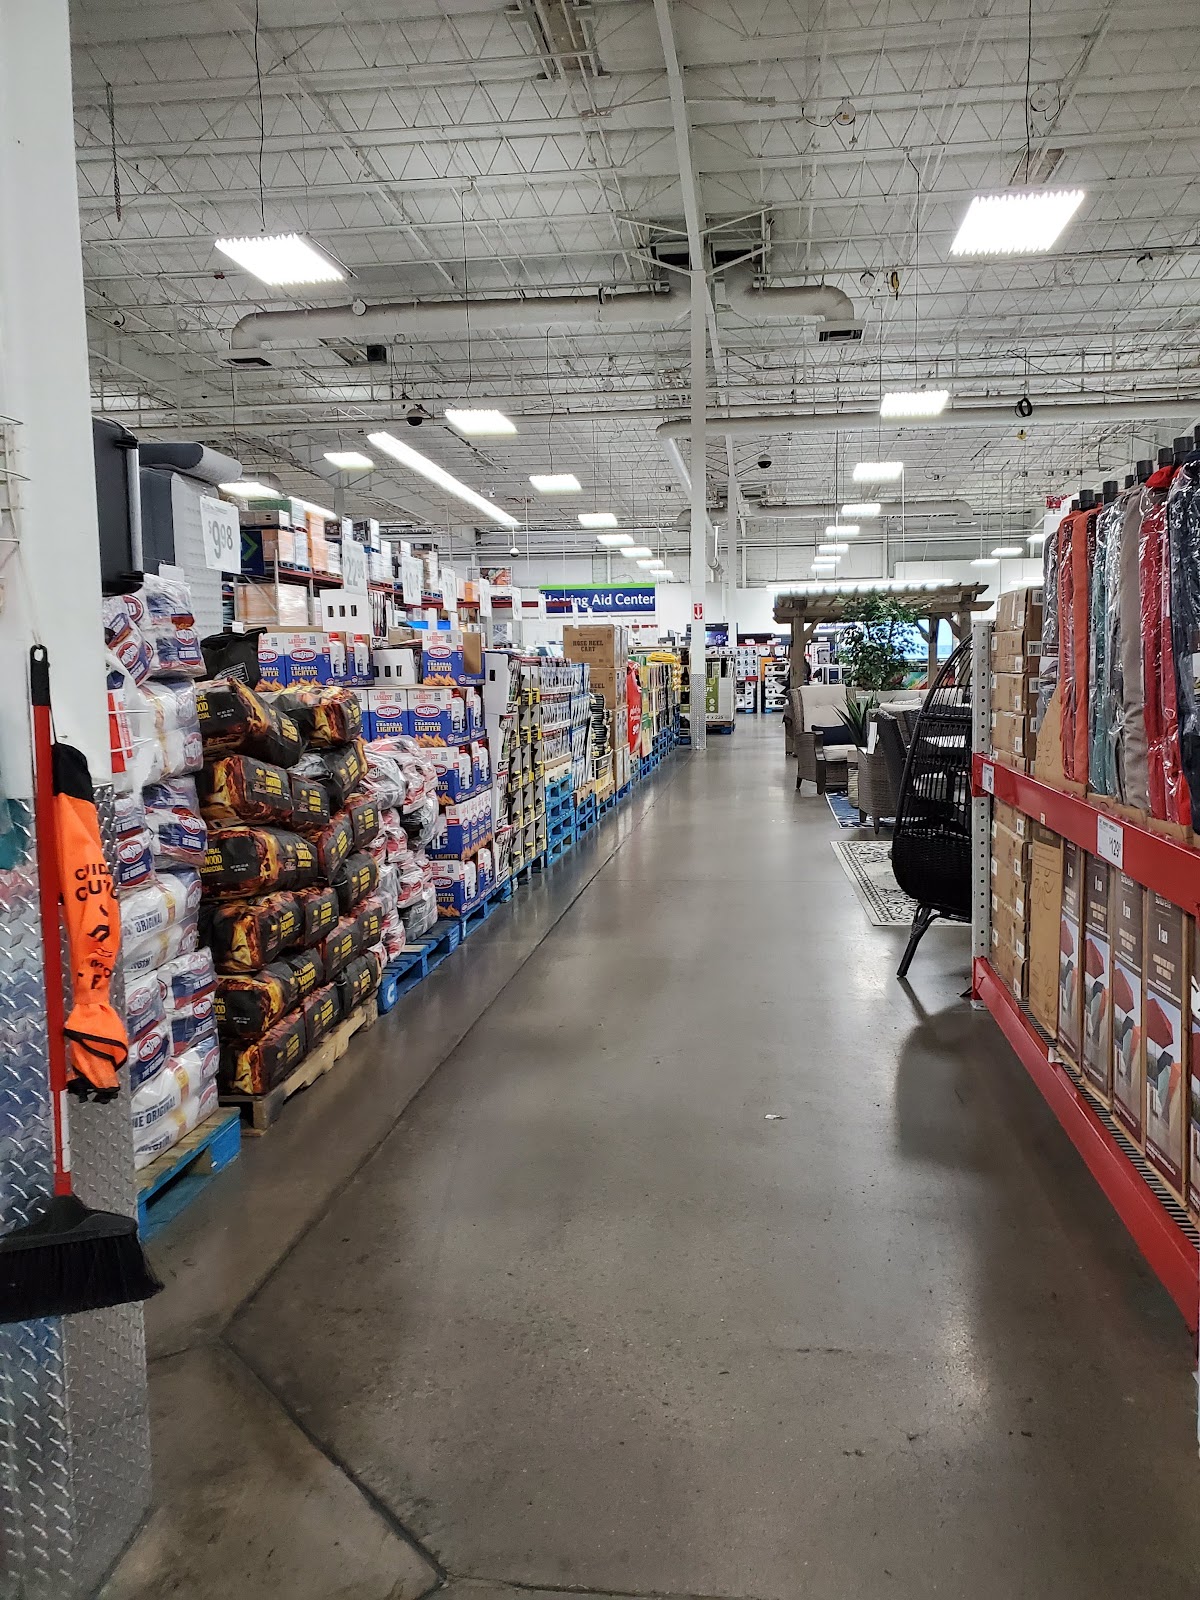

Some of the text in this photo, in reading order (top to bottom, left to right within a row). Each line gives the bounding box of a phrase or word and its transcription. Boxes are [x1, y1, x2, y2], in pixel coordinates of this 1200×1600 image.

[592, 594, 612, 605] Aid
[615, 593, 655, 605] Center
[146, 1096, 176, 1124] ORIGINAL
